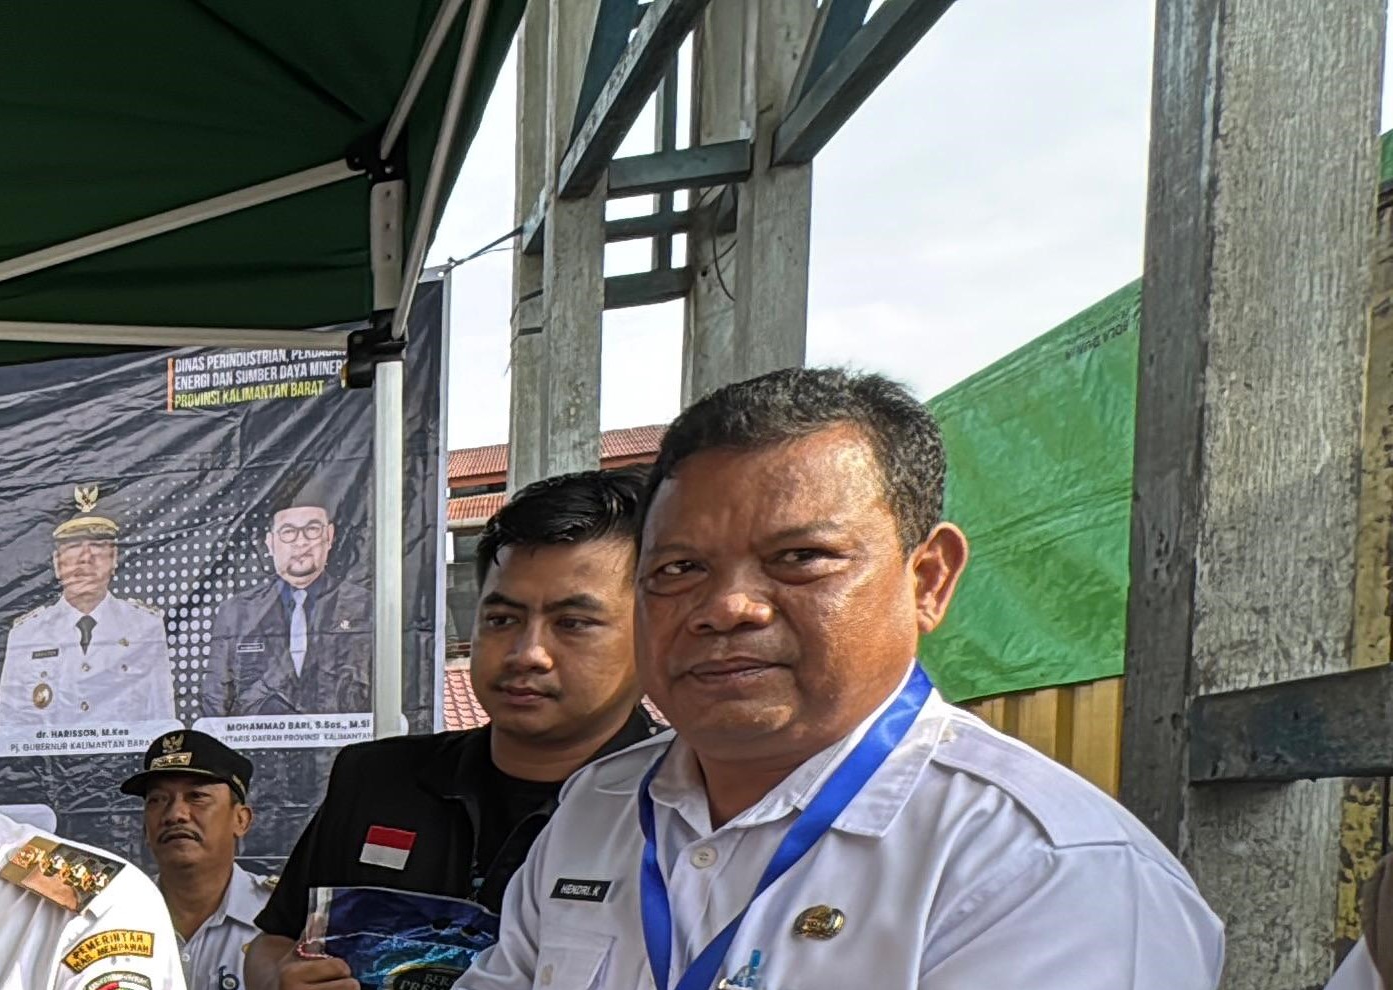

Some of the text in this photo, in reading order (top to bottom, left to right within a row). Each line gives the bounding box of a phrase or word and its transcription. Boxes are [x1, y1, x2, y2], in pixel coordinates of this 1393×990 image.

[175, 356, 205, 373] DINAS
[175, 358, 348, 391] ENERGI DAN SUMBER DAYA MINER
[175, 380, 325, 408] PROVINSI KALIMANTAN BARAT
[226, 721, 286, 731] MOHAMMAD
[22, 742, 68, 751] GUBERNUR
[70, 740, 125, 749] KALIMANTAN
[127, 739, 151, 748] BARA
[73, 931, 144, 959] PEMERINTAH
[97, 943, 149, 956] MEMPAWAH
